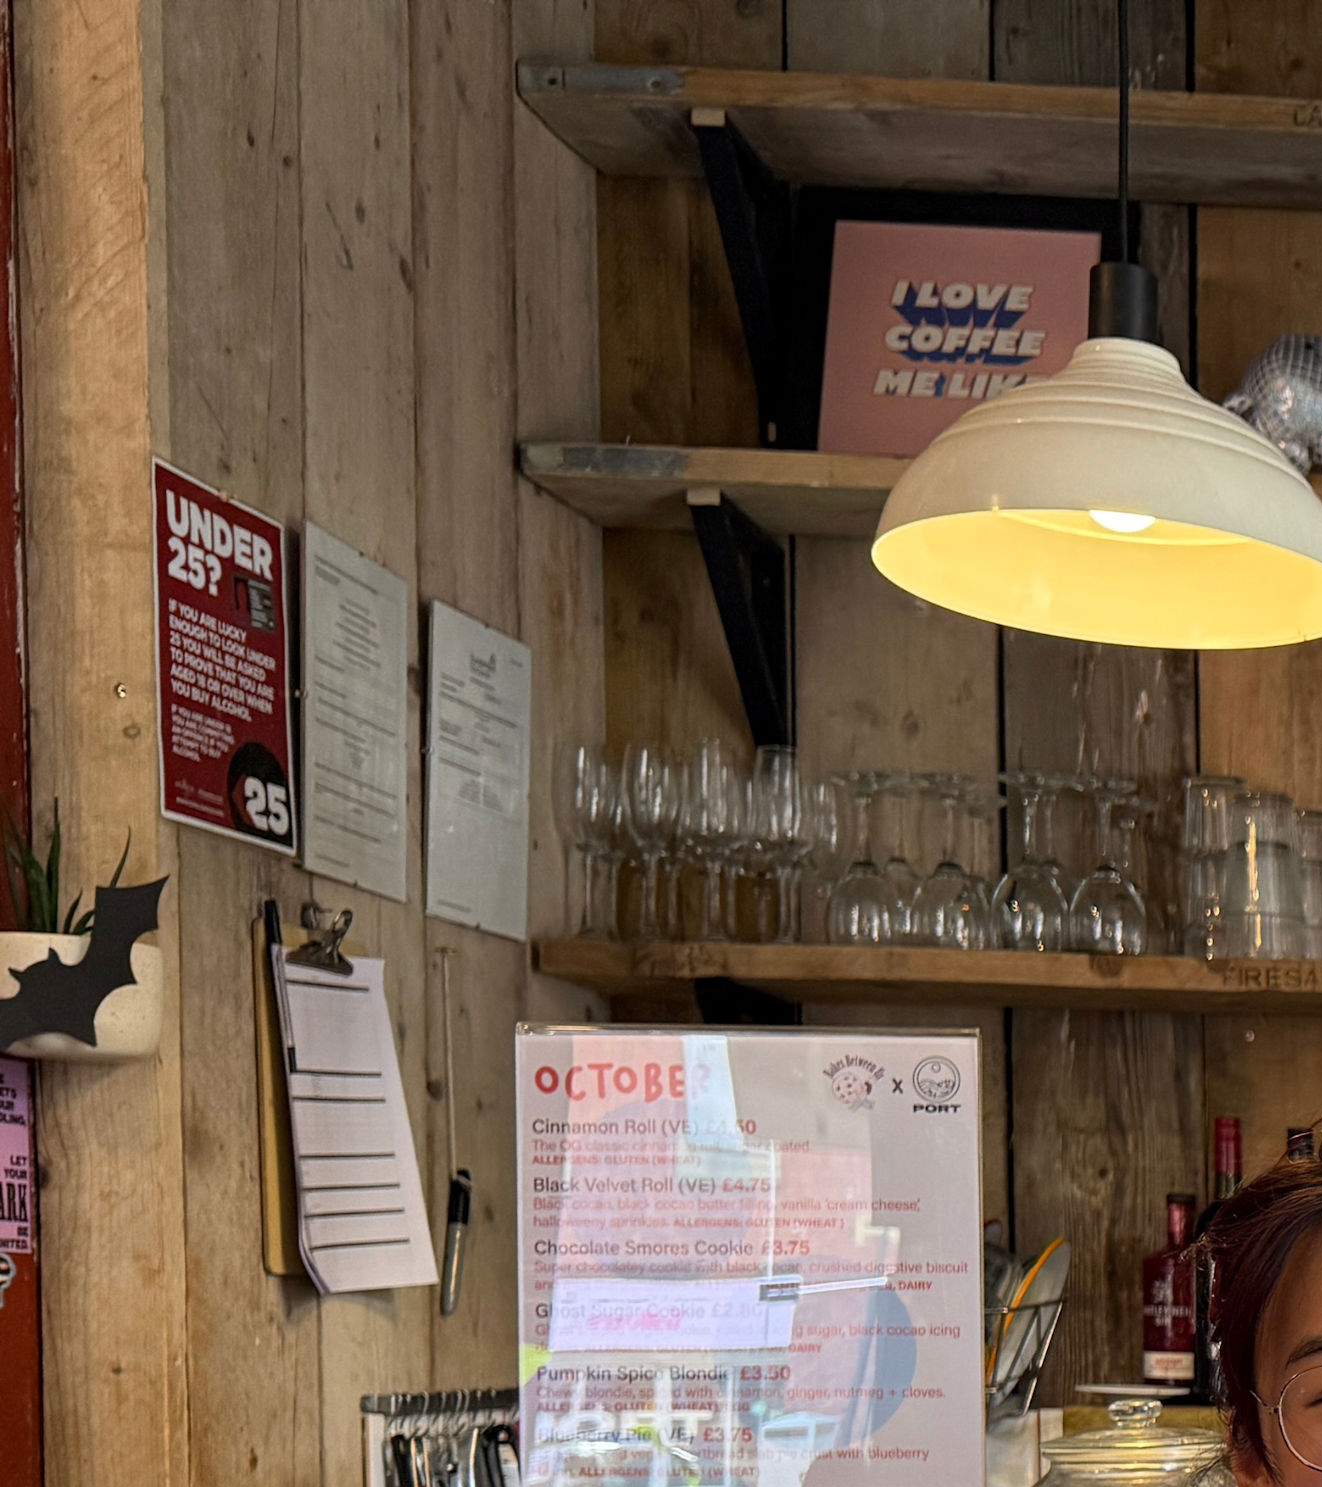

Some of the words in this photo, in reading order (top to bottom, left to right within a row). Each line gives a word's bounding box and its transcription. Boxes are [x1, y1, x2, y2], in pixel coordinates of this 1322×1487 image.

[892, 280, 910, 307] I
[915, 280, 1033, 311] LOVE
[885, 325, 1046, 356] COFFEE
[873, 369, 941, 397] ME
[166, 489, 273, 581] UNDER
[168, 536, 222, 597] 25?
[244, 776, 290, 836] 25
[913, 1104, 961, 1113] PORT
[532, 1119, 619, 1135] Cinnamon
[625, 1119, 656, 1135] Roll
[533, 1177, 580, 1193] Black
[584, 1178, 636, 1193] Velvet
[641, 1178, 673, 1193] Roll
[678, 1178, 716, 1195] (VE)
[722, 1178, 770, 1193] £4.75
[534, 1240, 619, 1256] Chocolate
[625, 1240, 689, 1256] Smores
[695, 1240, 753, 1256] Cookie
